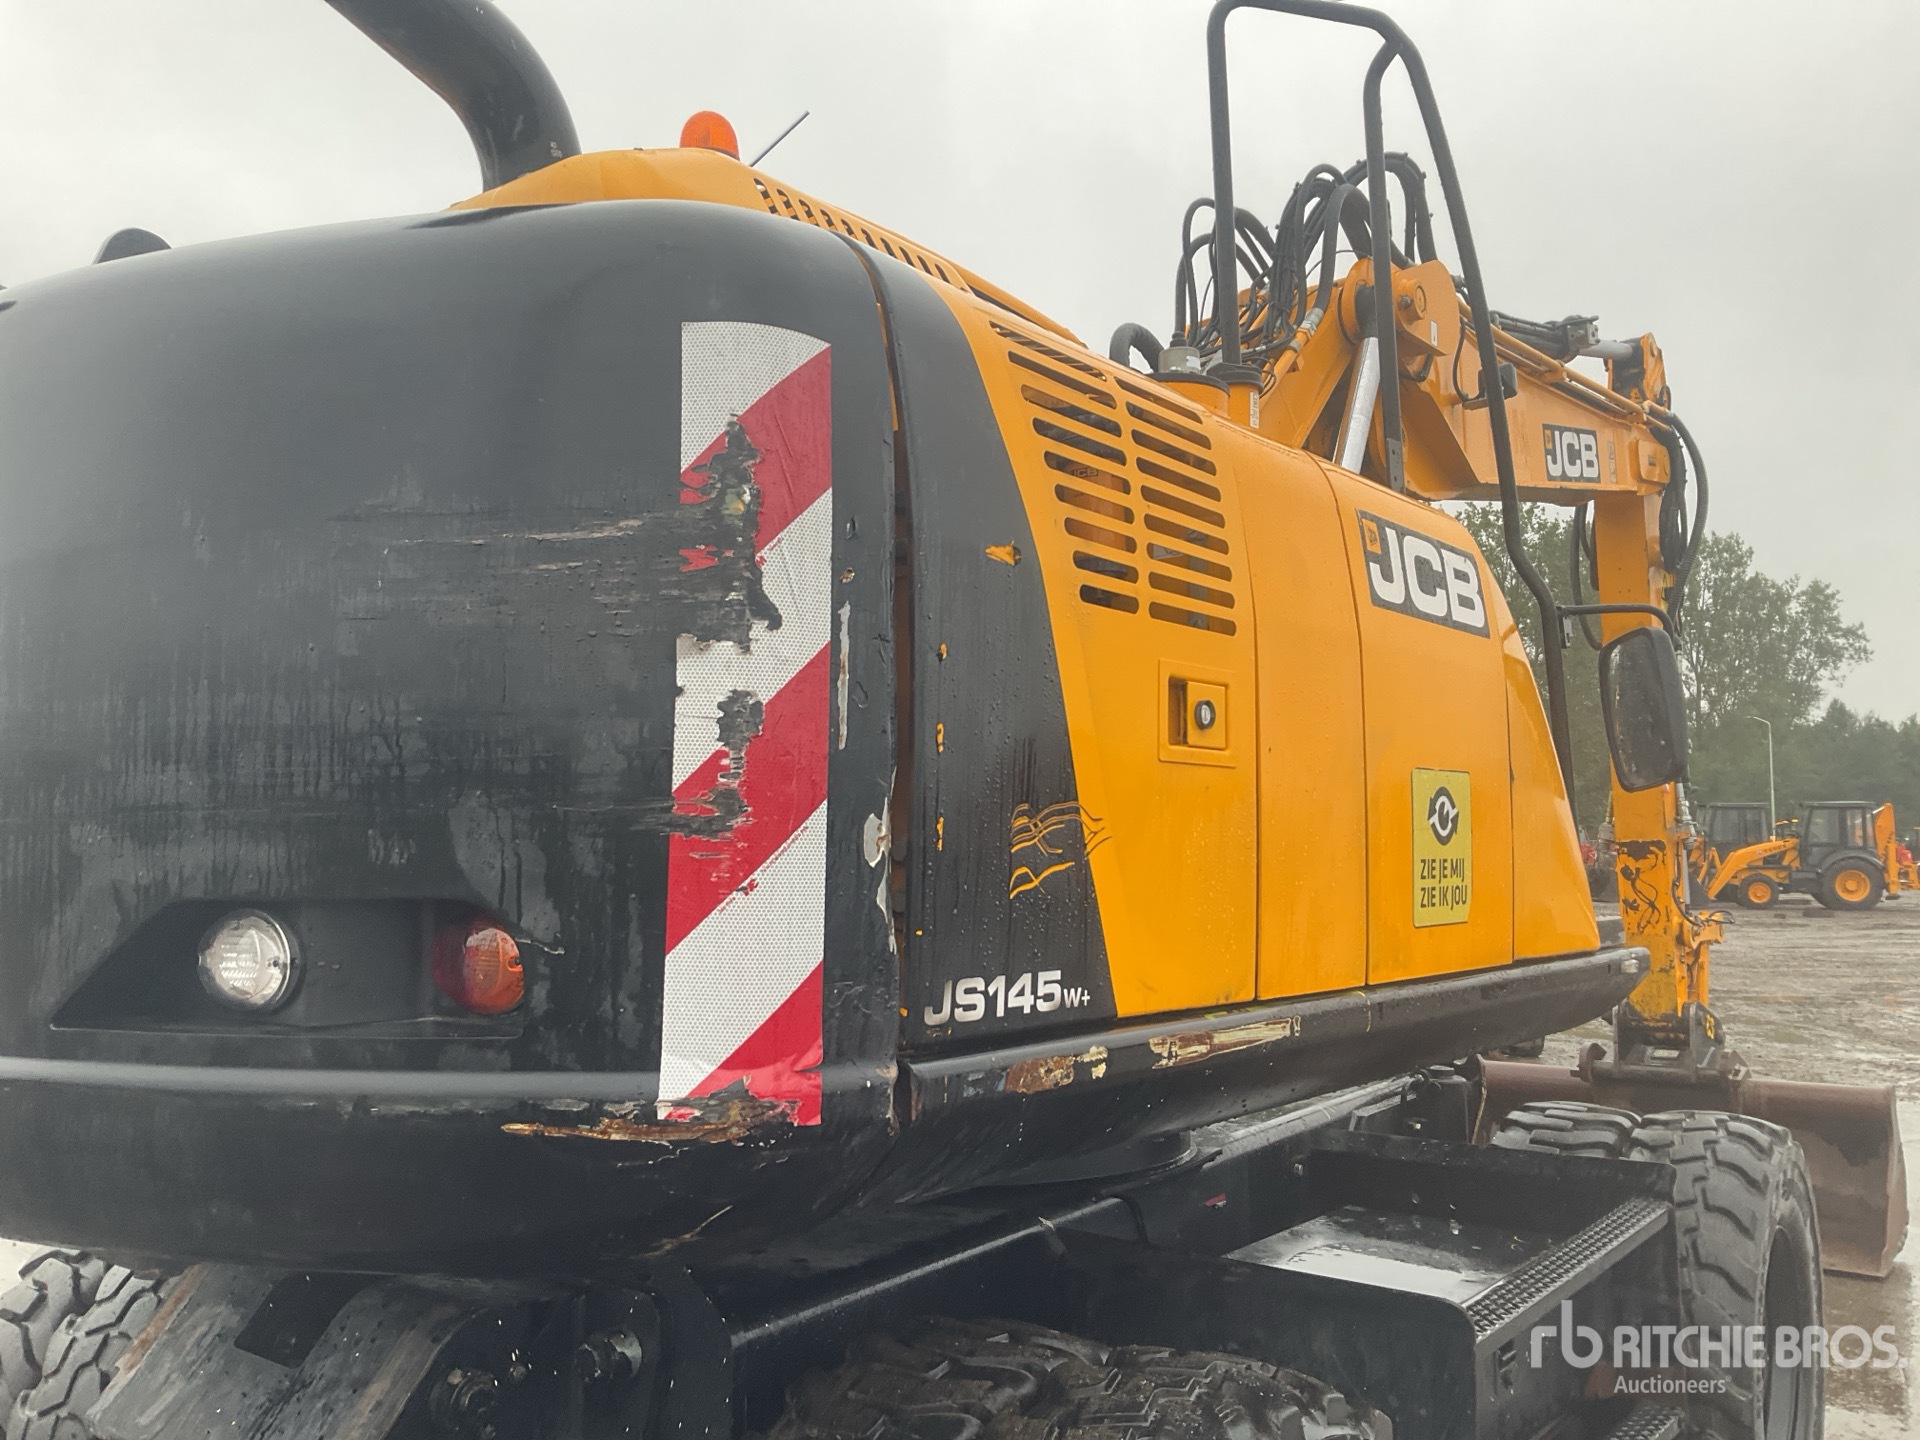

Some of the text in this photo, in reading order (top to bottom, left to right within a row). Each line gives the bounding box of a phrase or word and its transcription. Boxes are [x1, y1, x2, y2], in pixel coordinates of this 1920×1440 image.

[1546, 430, 1599, 478] JCB
[1369, 526, 1485, 628] JCB
[1420, 858, 1465, 884] ZIE JE MIJ
[1420, 884, 1468, 911] ZIE IK JOU
